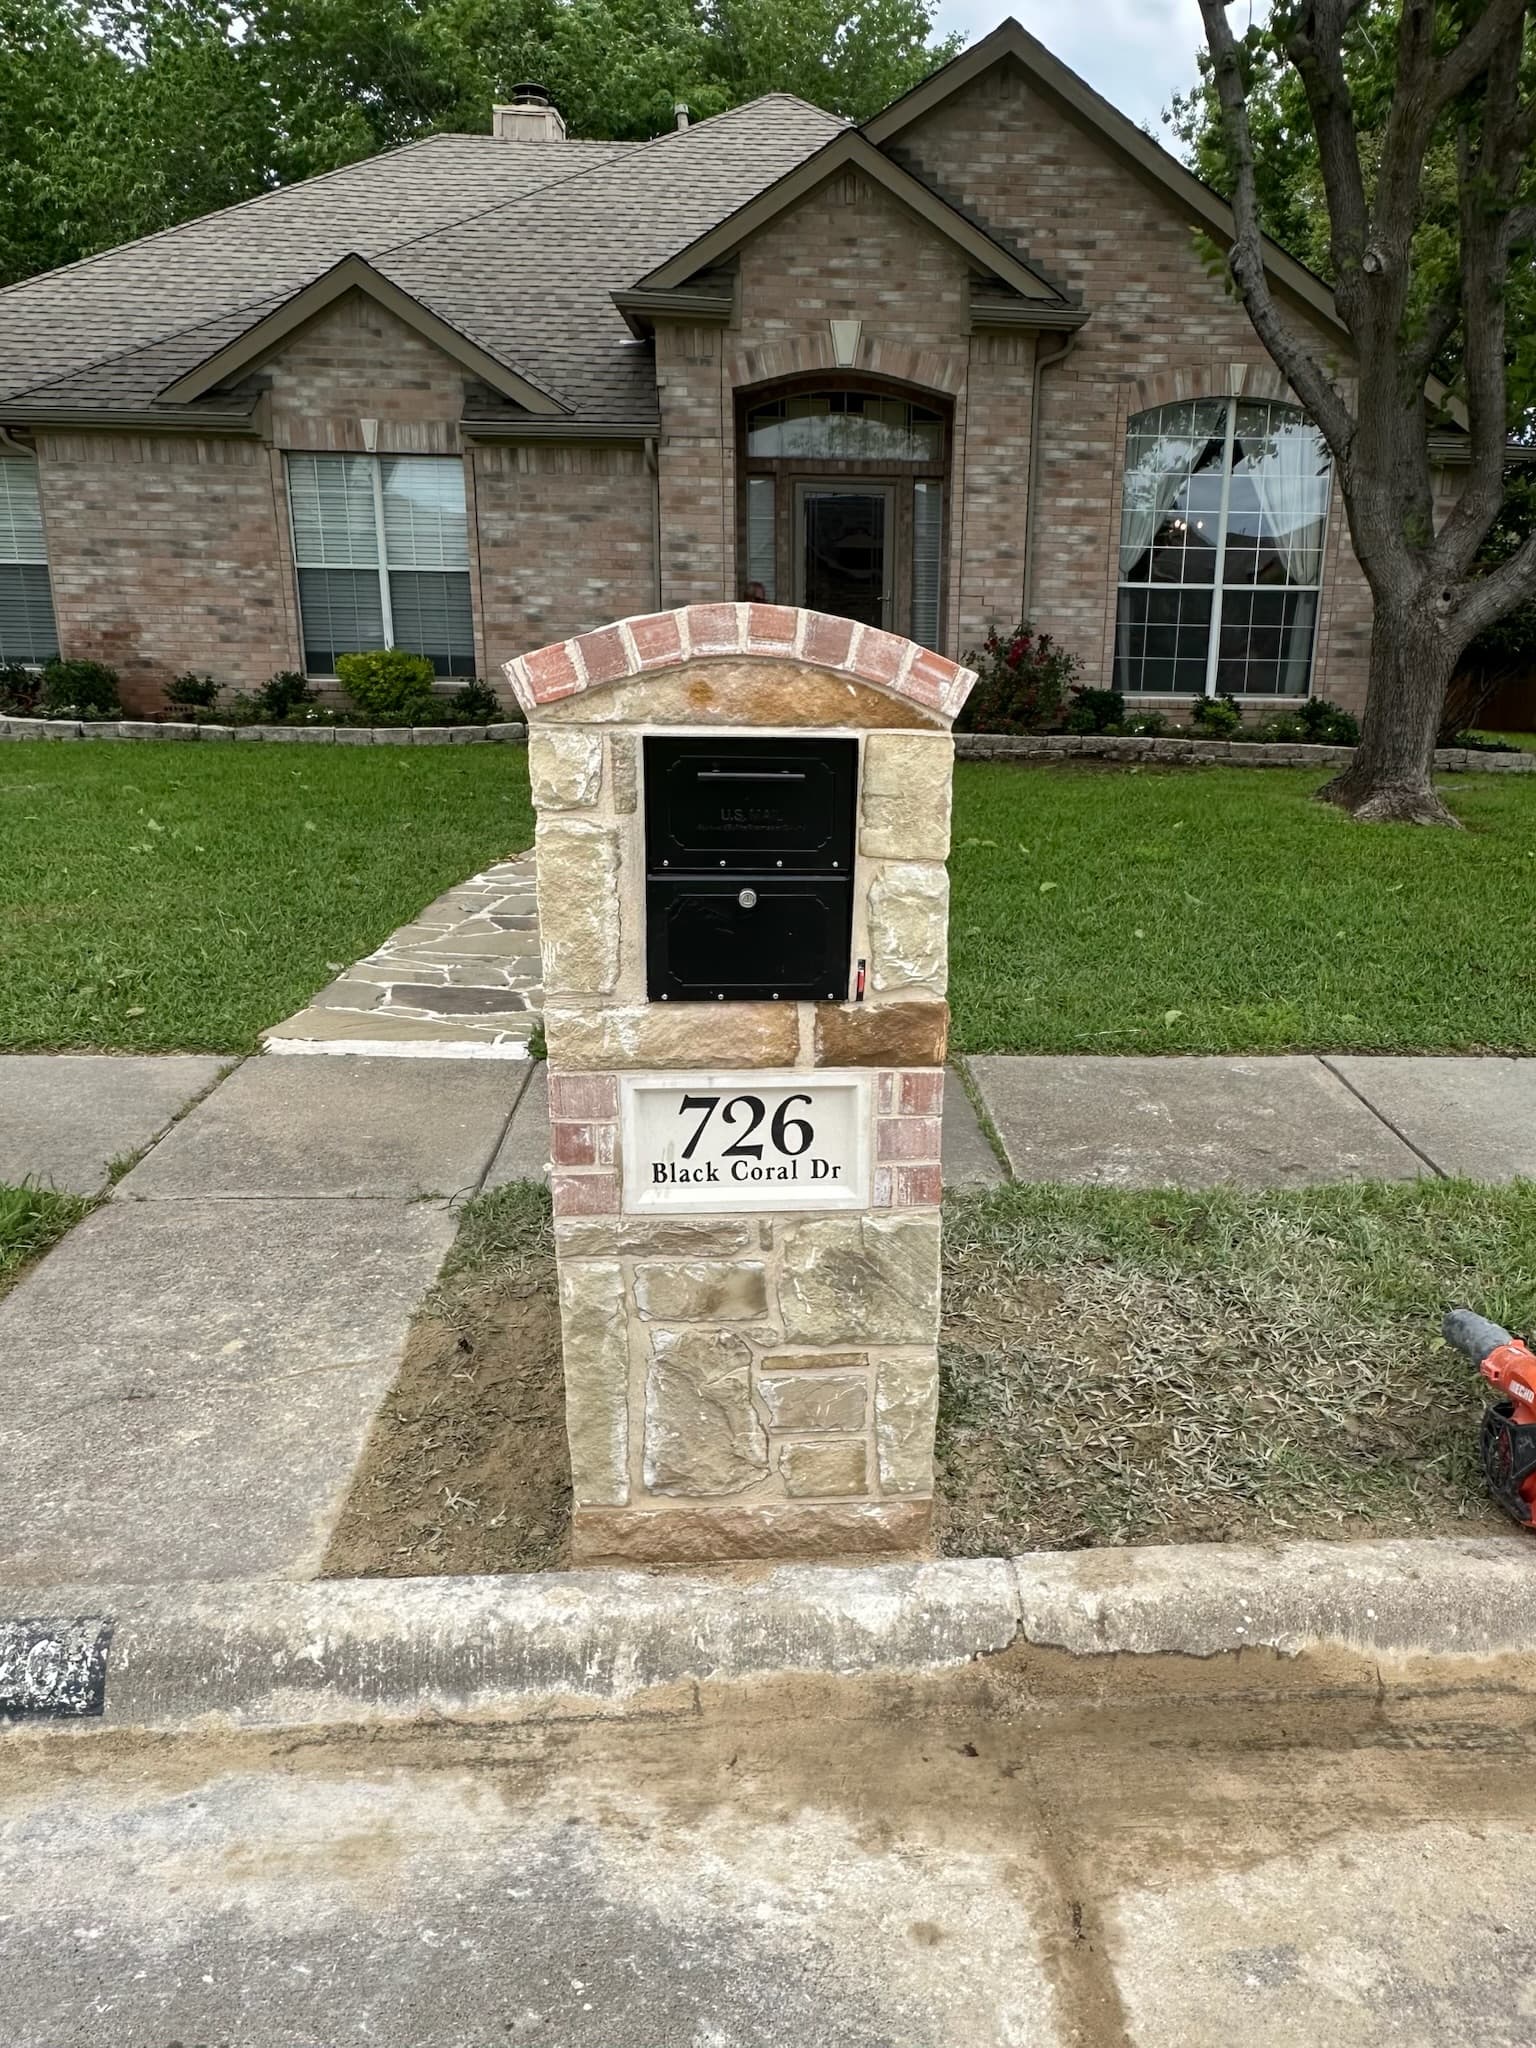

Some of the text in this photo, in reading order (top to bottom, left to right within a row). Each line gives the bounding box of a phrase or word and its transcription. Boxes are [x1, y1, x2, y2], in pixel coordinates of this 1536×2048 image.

[678, 1094, 814, 1160] 726
[652, 1158, 841, 1184] Black Coral Dr
